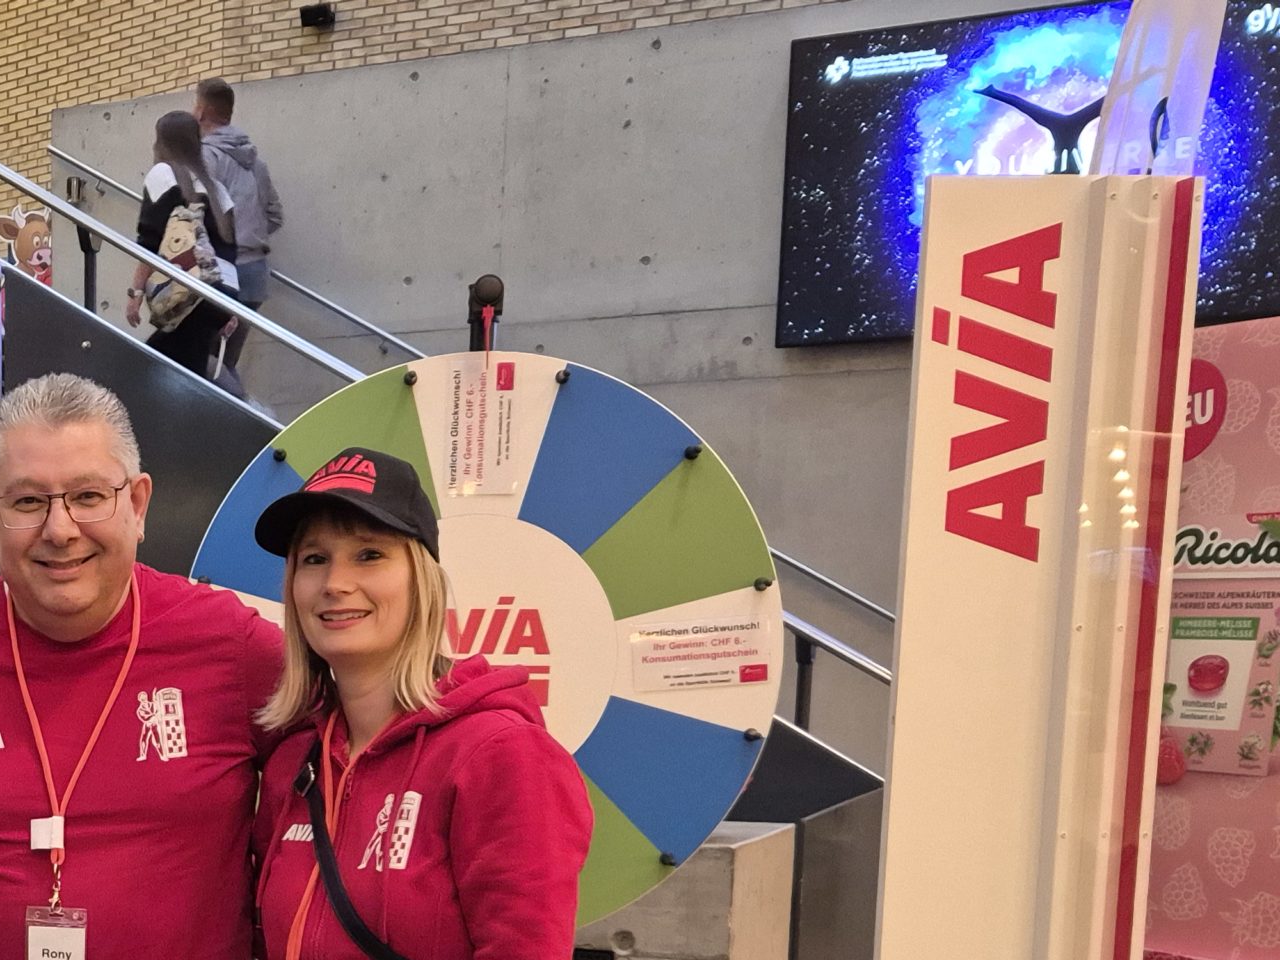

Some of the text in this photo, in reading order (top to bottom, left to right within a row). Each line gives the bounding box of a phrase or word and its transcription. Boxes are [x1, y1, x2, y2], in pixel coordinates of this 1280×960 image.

[465, 398, 474, 418] CHF
[1174, 530, 1280, 566] Ricola
[691, 621, 760, 634] Glückwunsch!
[653, 642, 666, 651] Ihr
[669, 640, 708, 650] Gewinn:
[710, 638, 731, 647] CHF
